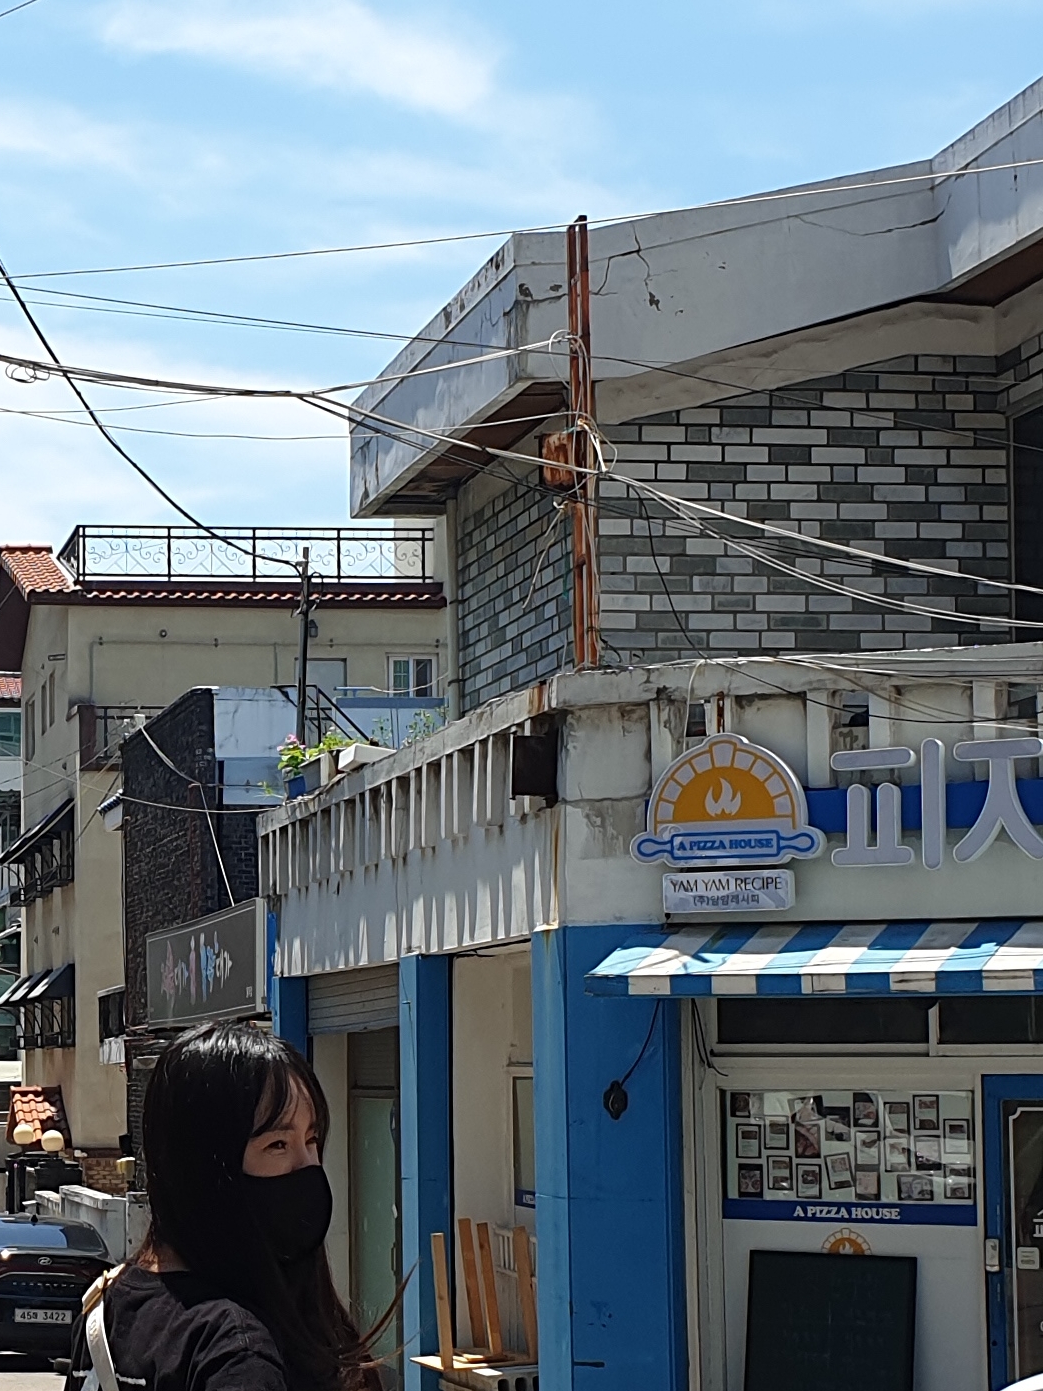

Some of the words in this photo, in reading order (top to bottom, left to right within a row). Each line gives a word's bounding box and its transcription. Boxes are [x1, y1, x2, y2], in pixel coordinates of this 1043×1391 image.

[677, 840, 687, 851] A
[689, 839, 727, 851] PIZZA
[729, 838, 774, 849] HOUSE
[670, 879, 698, 893] YAM
[702, 878, 730, 892] YAM
[735, 876, 782, 891] RECIPE
[793, 1205, 805, 1217] A
[806, 1206, 850, 1218] PIZZA
[851, 1207, 901, 1220] HOUSE
[42, 1311, 66, 1322] 3422
